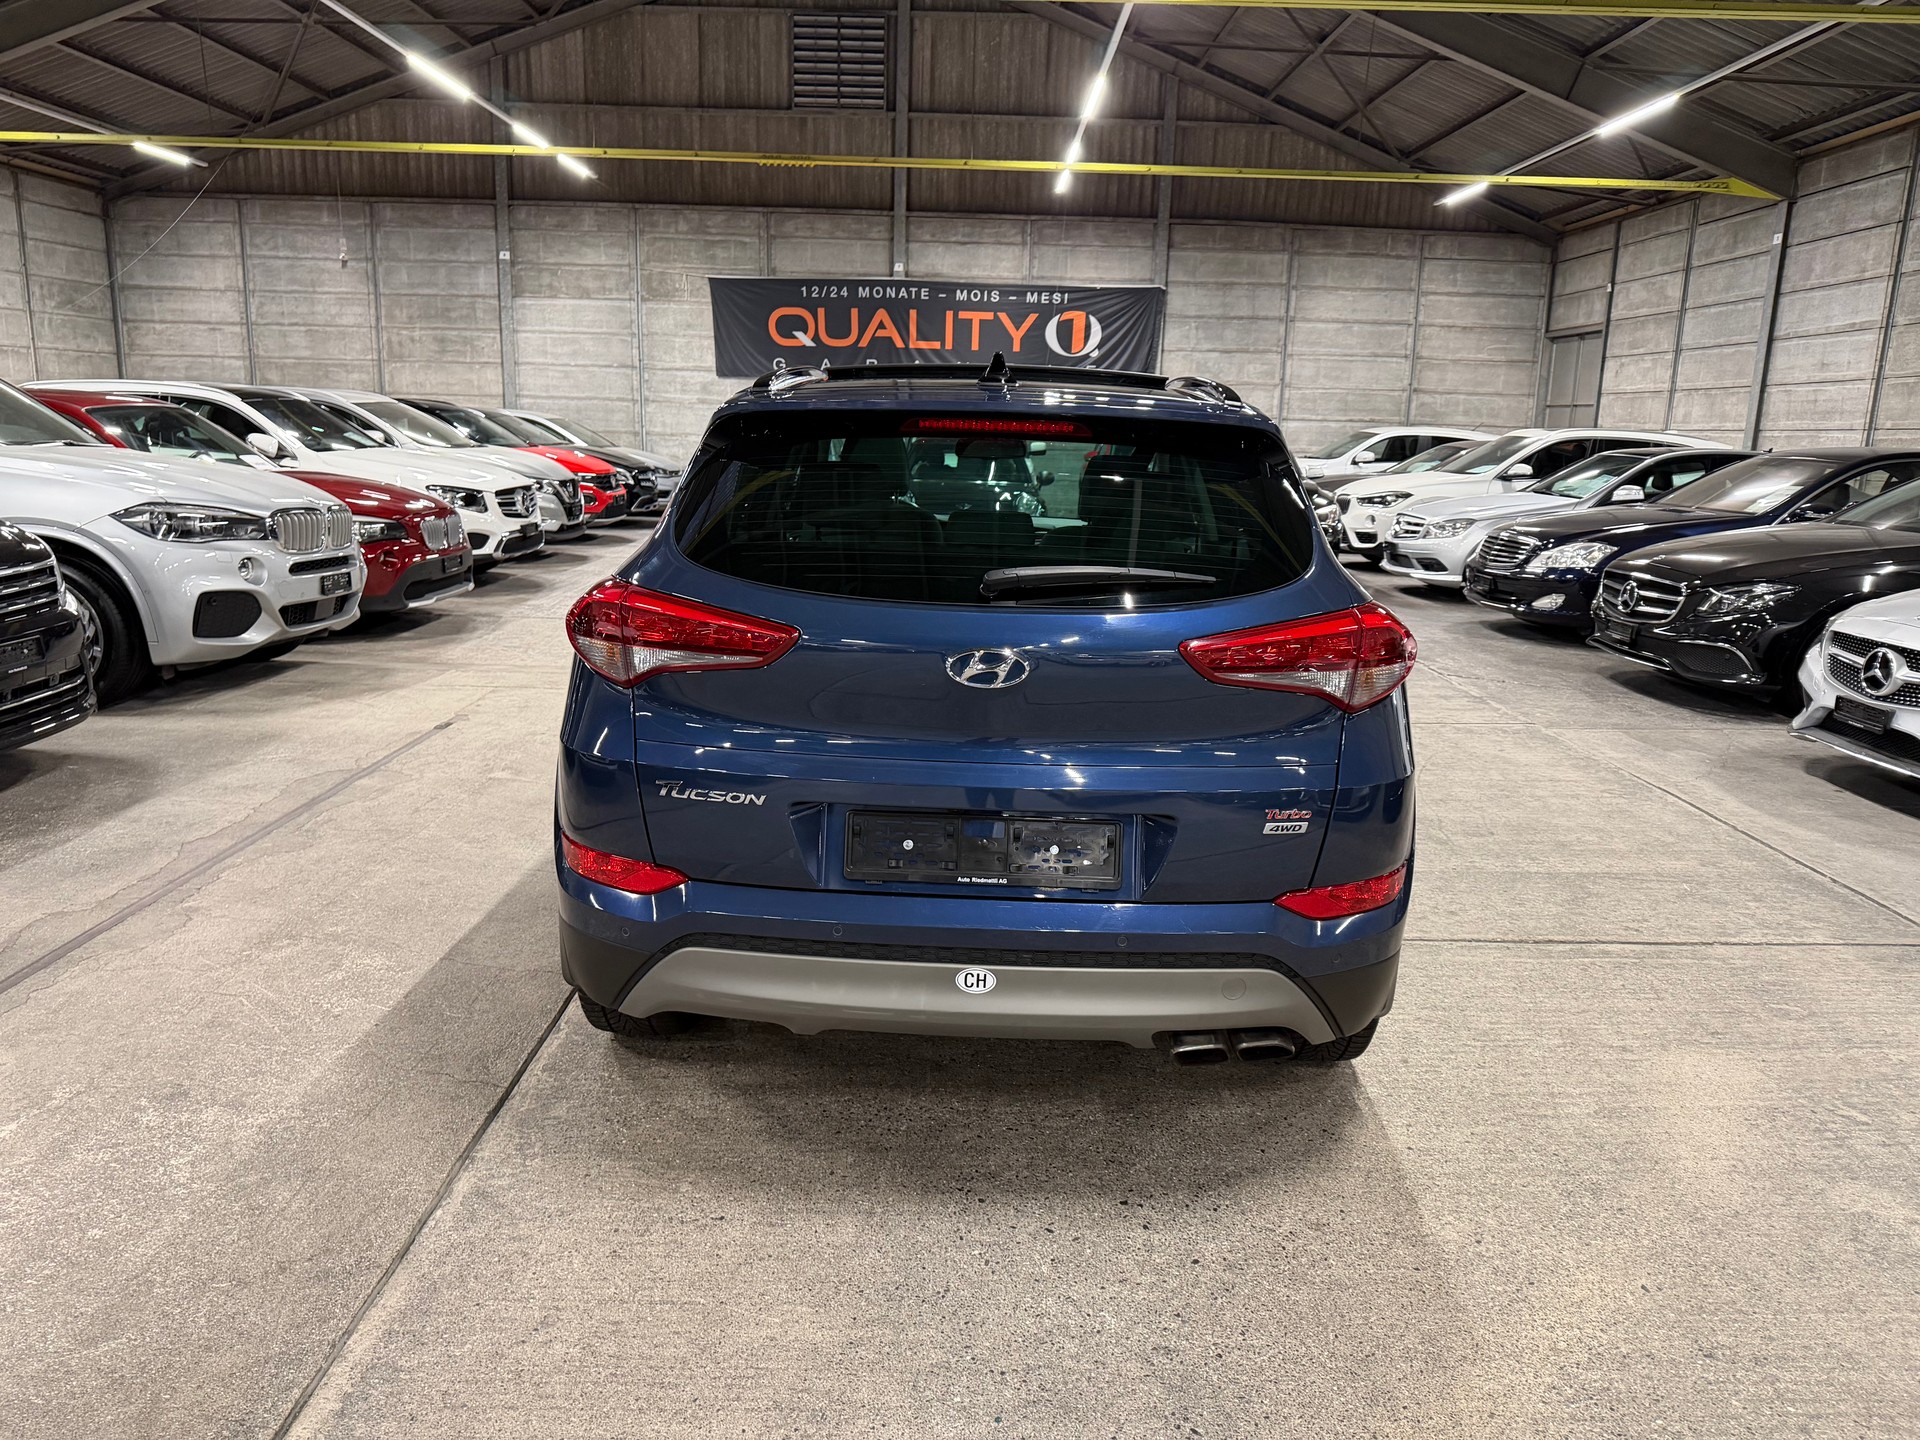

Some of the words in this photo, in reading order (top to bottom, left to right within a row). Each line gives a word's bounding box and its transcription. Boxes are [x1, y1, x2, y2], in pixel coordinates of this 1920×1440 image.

[800, 285, 849, 299] 12/24
[858, 286, 930, 300] MONATE
[955, 289, 1000, 303] MOIS
[1025, 291, 1069, 304] MESI
[768, 306, 1040, 353] QUALITY
[655, 779, 767, 806] TUCSON
[1264, 808, 1313, 820] Turbo
[1269, 824, 1303, 833] 4WD
[964, 972, 987, 988] CH
